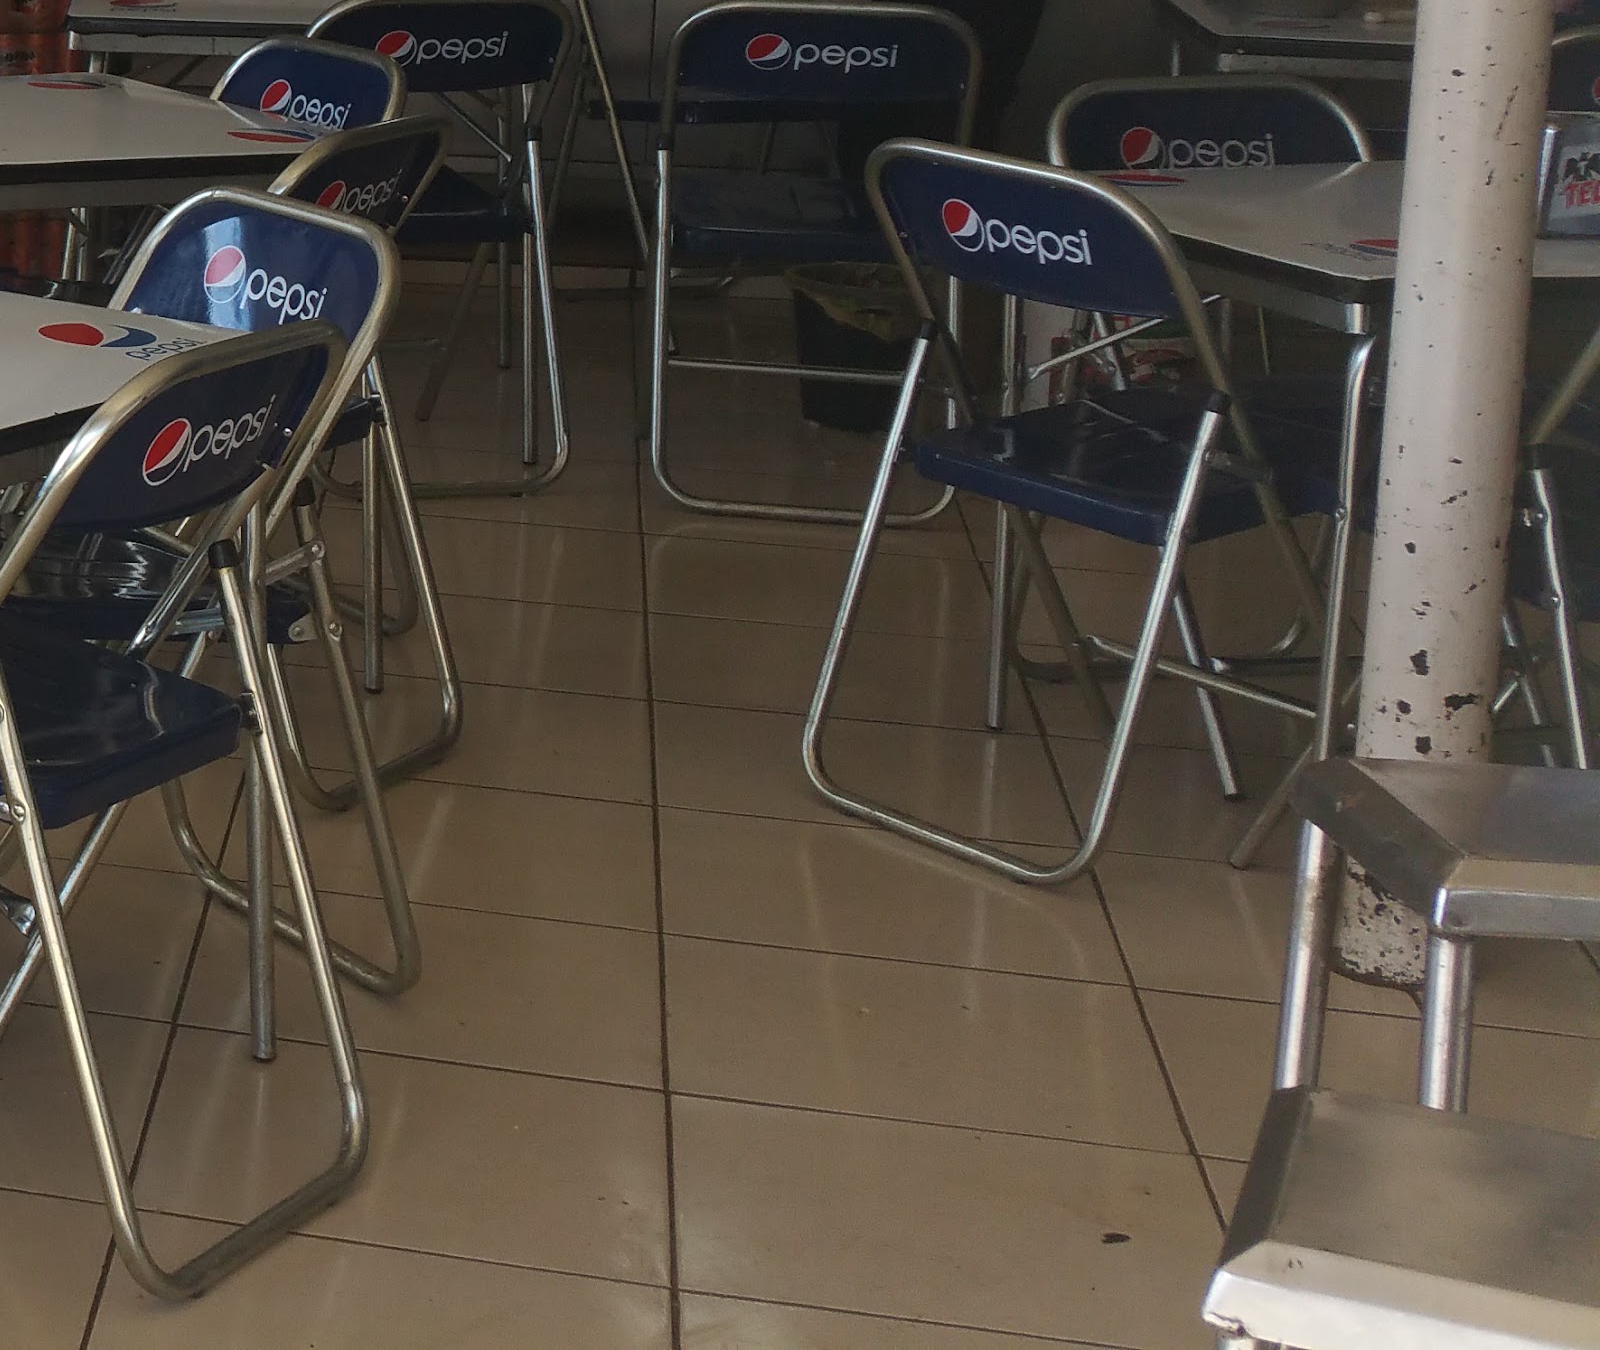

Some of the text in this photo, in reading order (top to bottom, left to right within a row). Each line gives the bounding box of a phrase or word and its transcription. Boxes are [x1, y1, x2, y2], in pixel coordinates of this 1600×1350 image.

[414, 32, 509, 64] pepsi
[794, 44, 898, 74] pepsi
[288, 94, 352, 131] pepsi
[1163, 134, 1275, 170] pepsi
[985, 216, 1093, 268] pepsi
[241, 265, 326, 326] pepsi
[184, 395, 275, 474] pepsi
